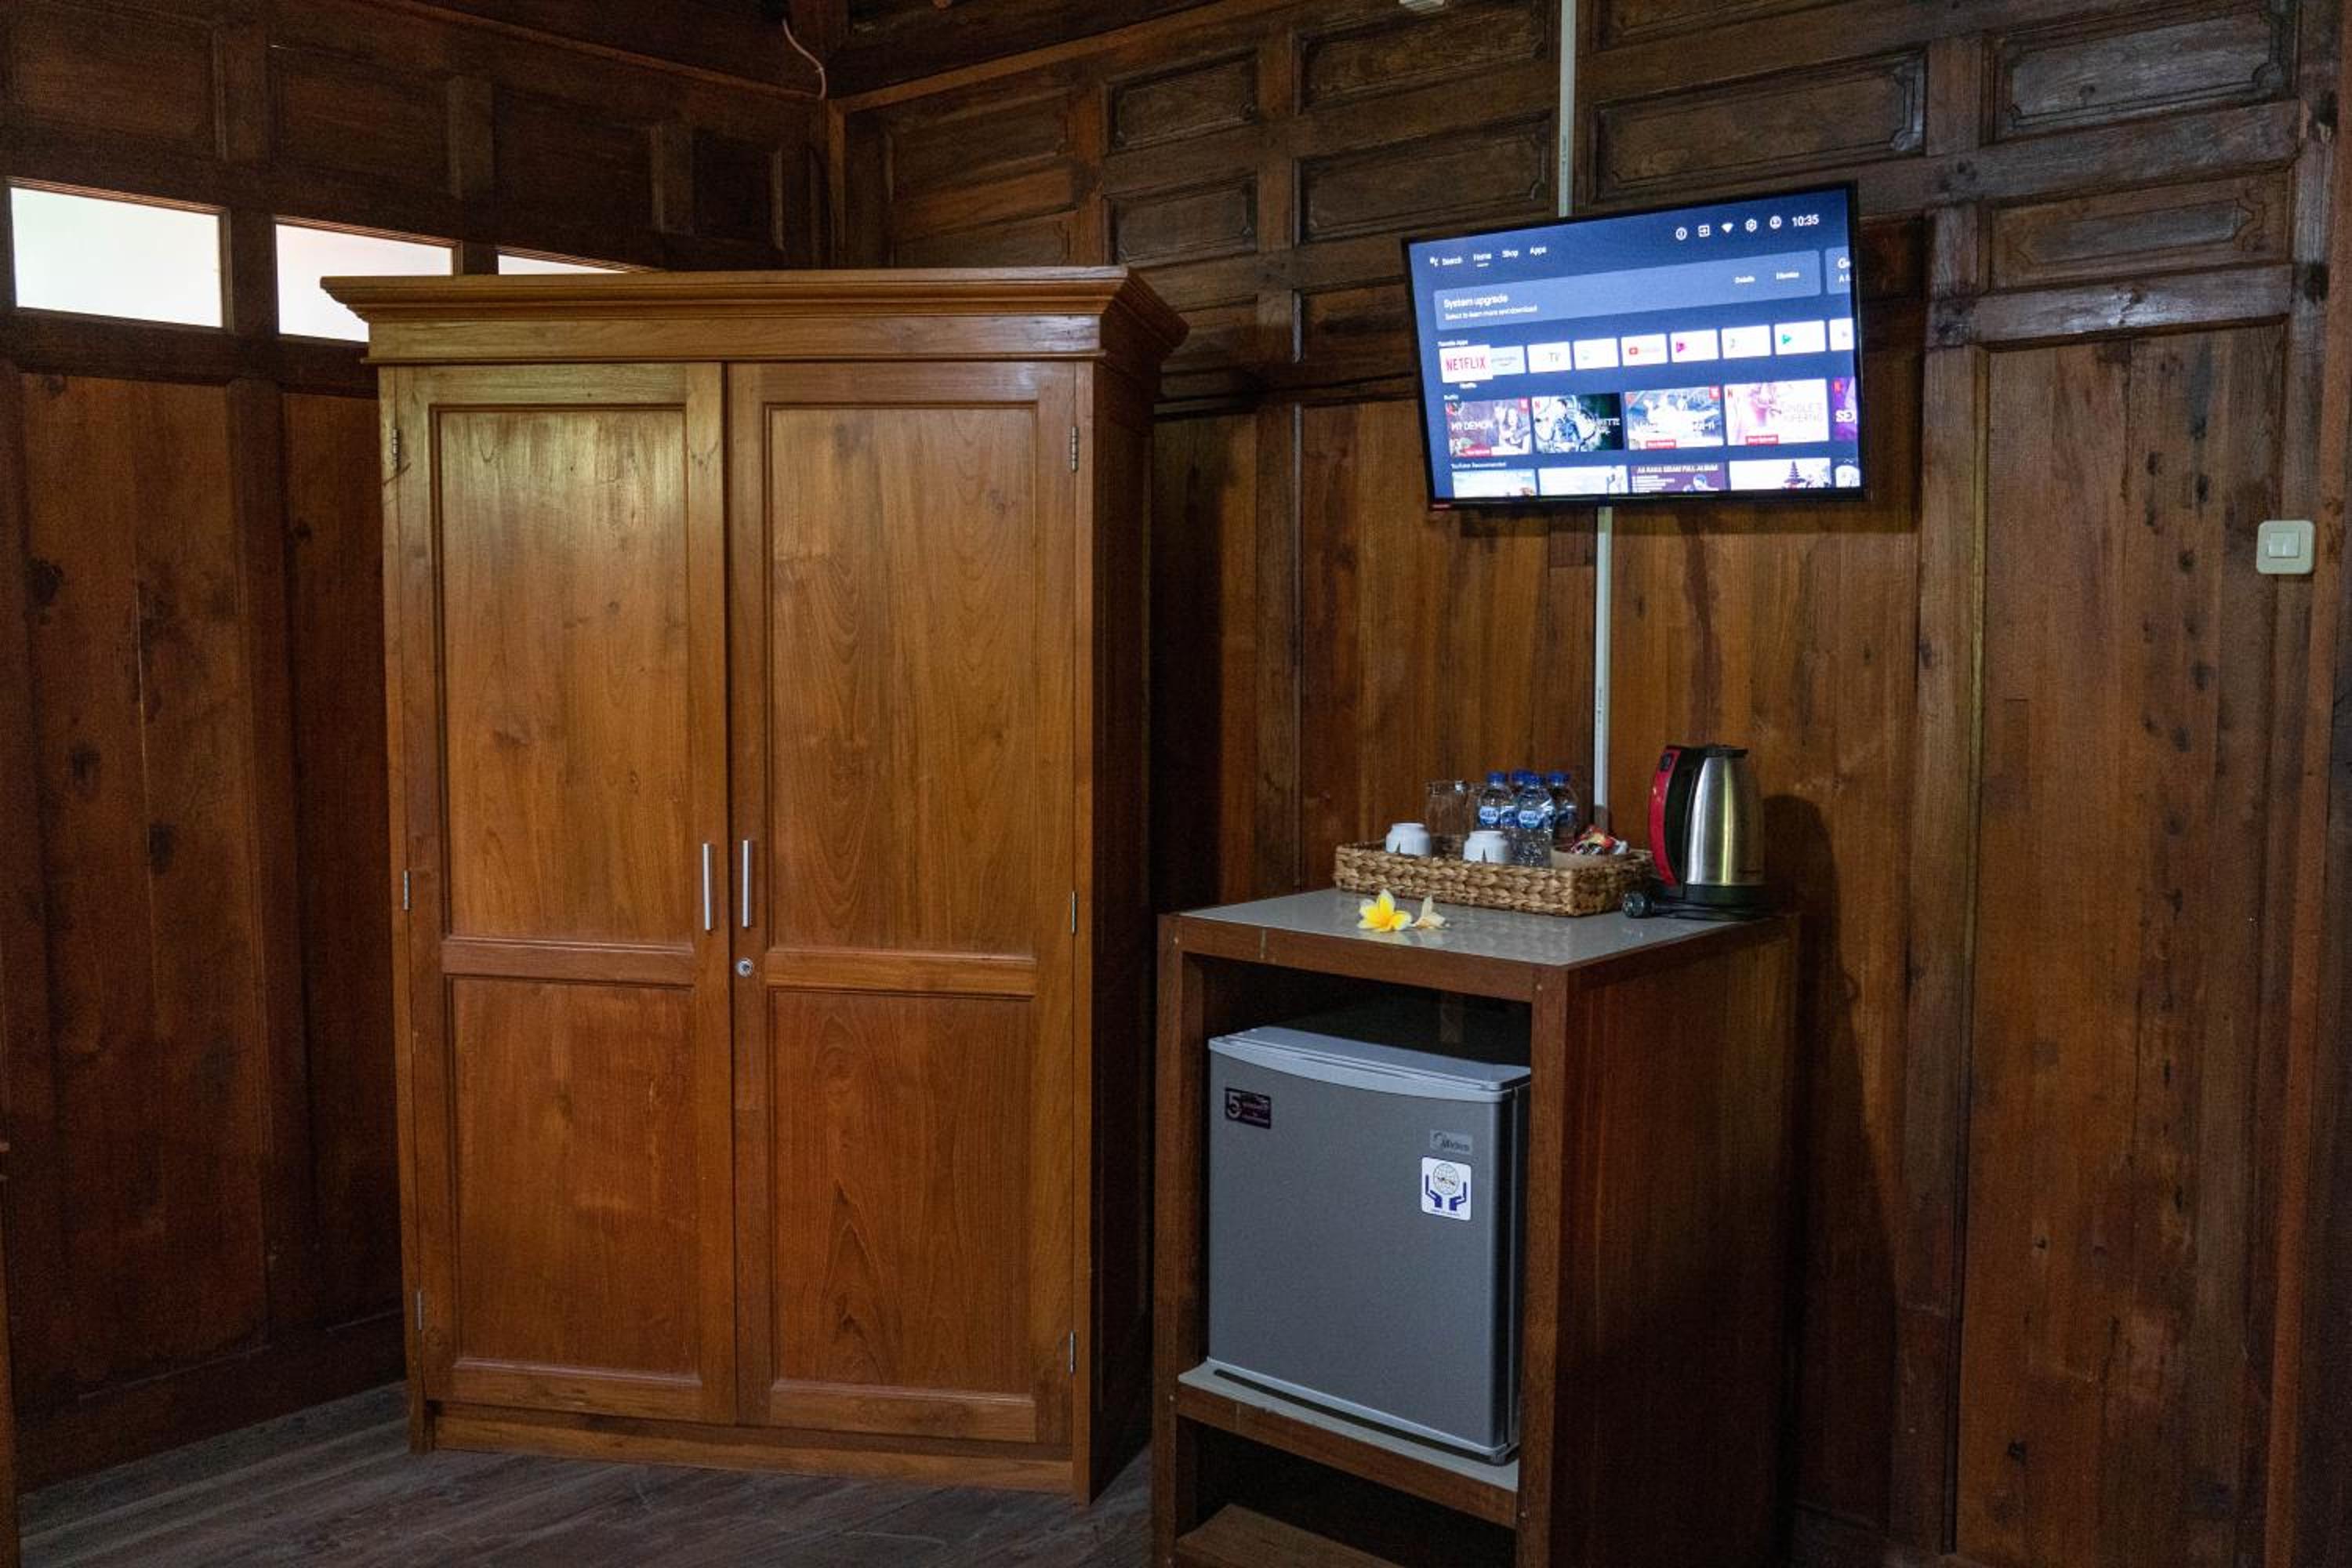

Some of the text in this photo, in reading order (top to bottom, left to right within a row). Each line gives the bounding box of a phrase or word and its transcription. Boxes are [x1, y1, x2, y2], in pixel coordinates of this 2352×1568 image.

[1791, 213, 1820, 227] 10:35
[1530, 246, 1547, 256] Apps
[1443, 294, 1508, 310] System upgrade
[1445, 357, 1486, 371] NETFLIX
[1548, 352, 1560, 362] TV
